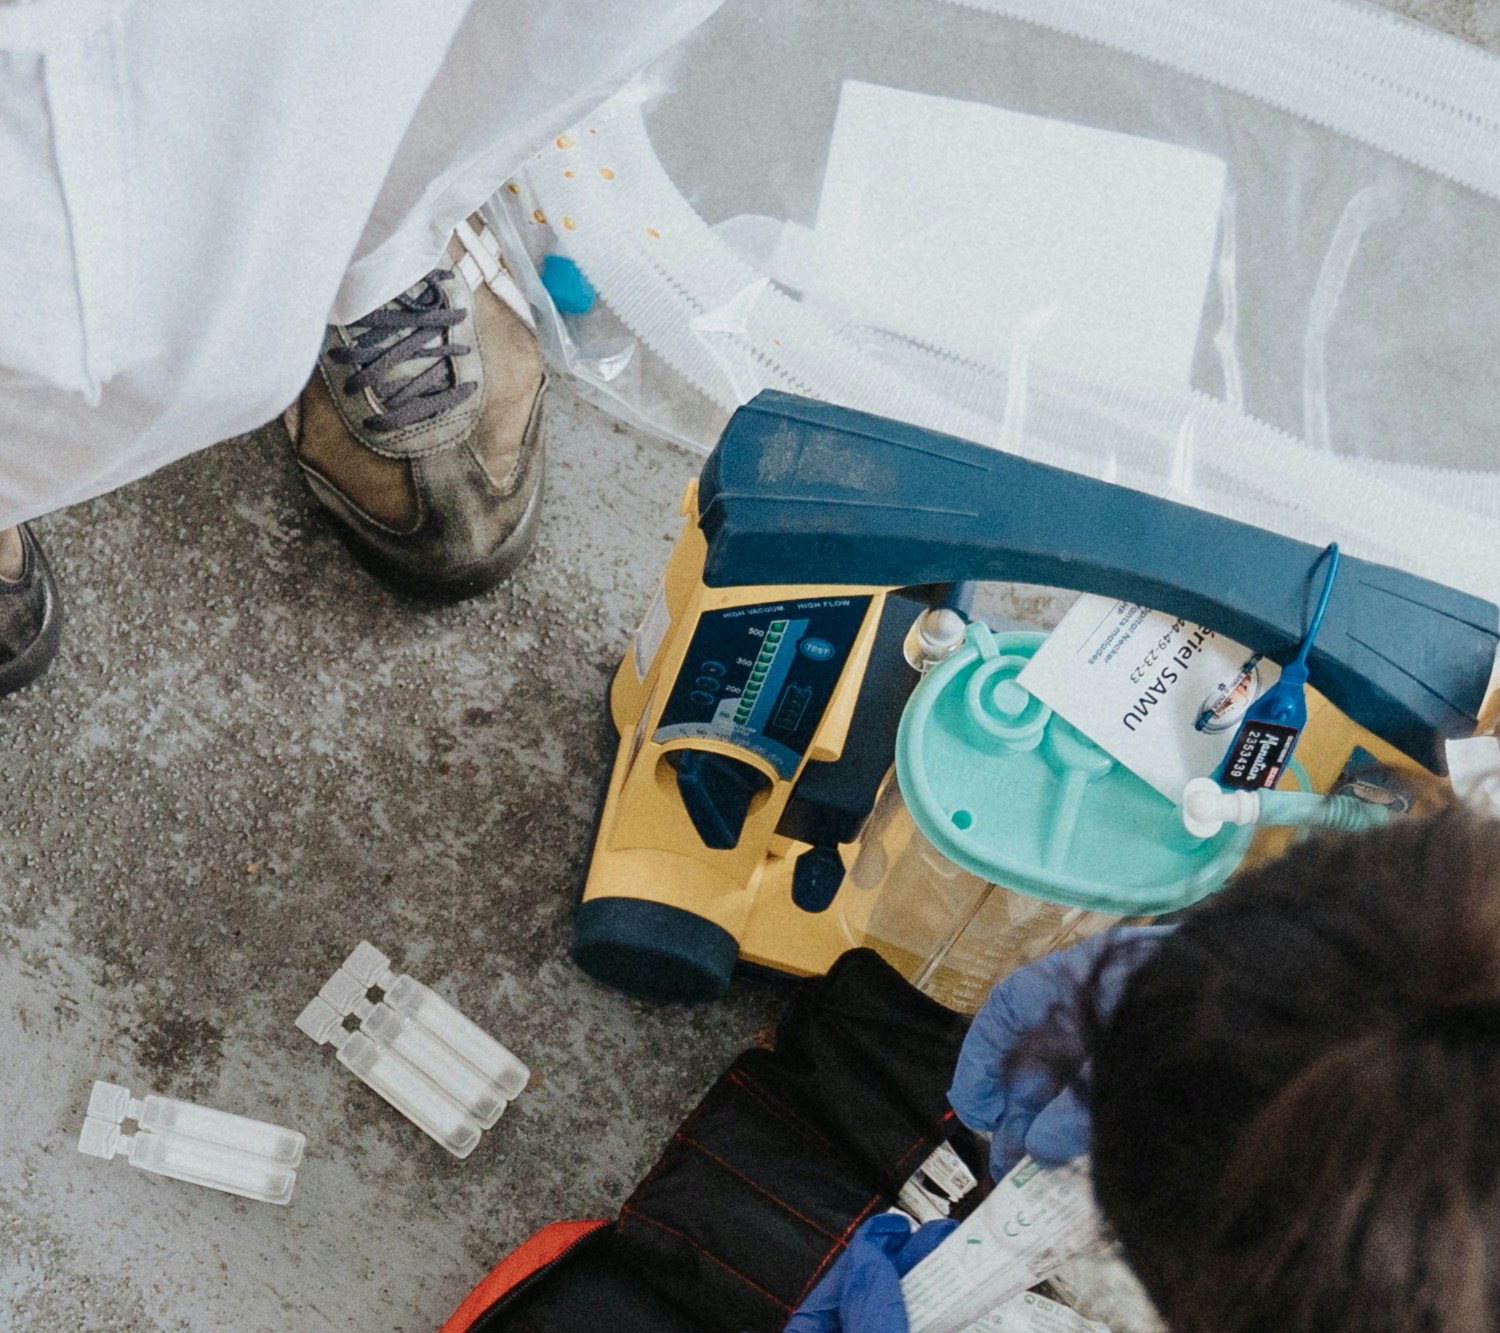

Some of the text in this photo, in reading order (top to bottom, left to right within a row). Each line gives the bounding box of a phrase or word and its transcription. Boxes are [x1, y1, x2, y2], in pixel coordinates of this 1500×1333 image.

[723, 610, 744, 618] HIGH
[748, 627, 764, 637] 500
[805, 644, 830, 655] TEST
[1086, 626, 1120, 666] malades
[1101, 631, 1130, 665] Necker
[736, 657, 753, 667] 350
[725, 685, 741, 694] 200
[1119, 666, 1178, 732] SAMU
[1230, 730, 1260, 777] 2353439
[1246, 733, 1278, 782] Manutan
